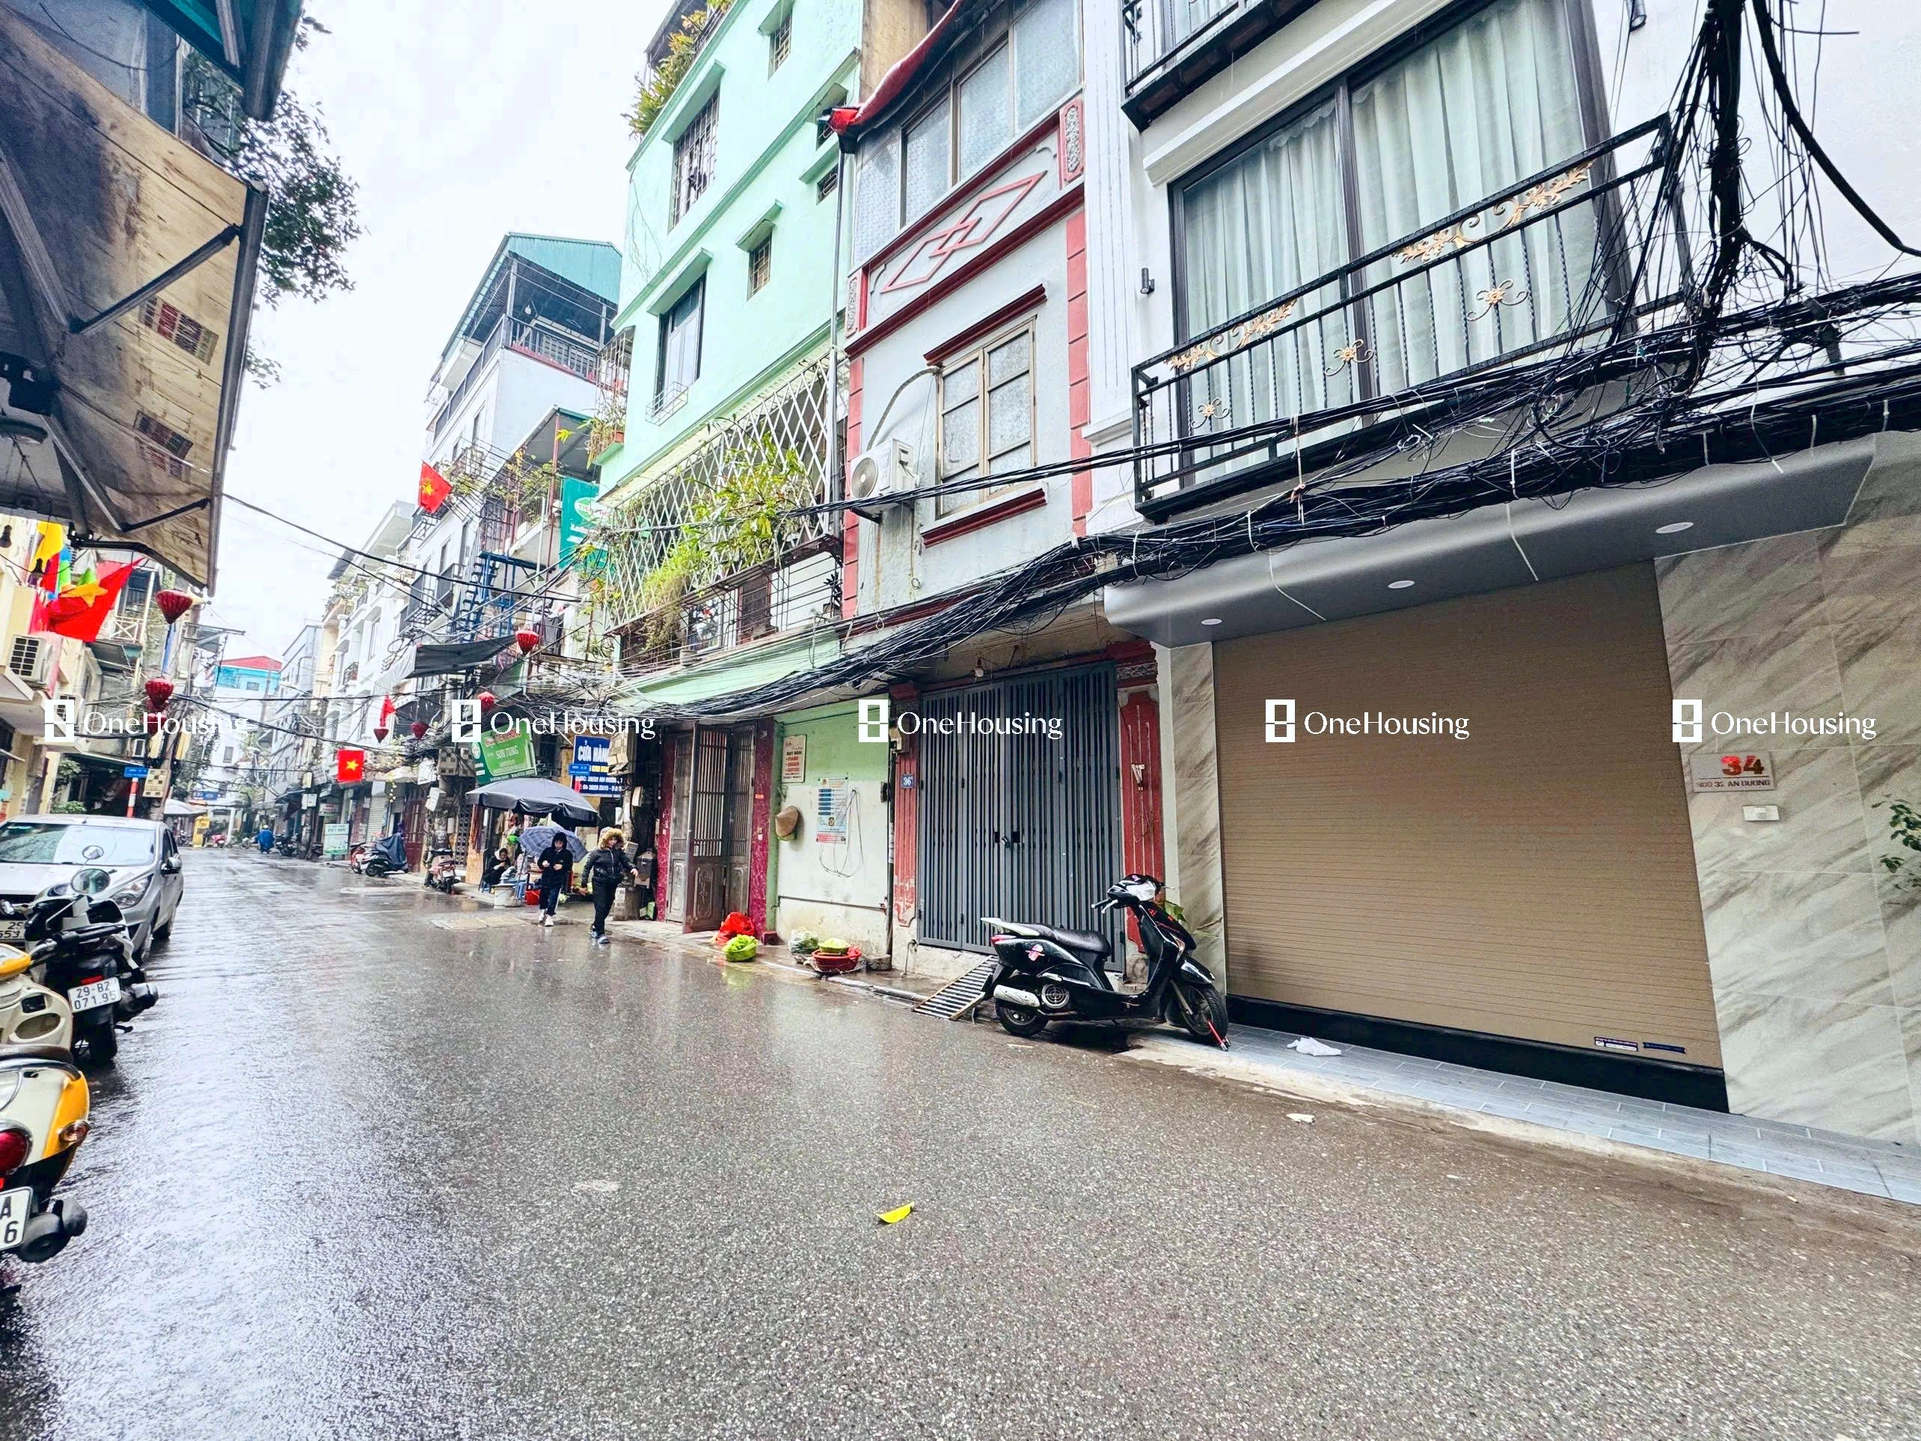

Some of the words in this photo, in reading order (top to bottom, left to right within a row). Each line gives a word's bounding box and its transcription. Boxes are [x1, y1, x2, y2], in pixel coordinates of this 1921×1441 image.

[592, 744, 609, 763] HÀN
[1720, 755, 1764, 776] 34
[76, 981, 111, 999] 29-B2
[74, 990, 118, 1010] 071.95
